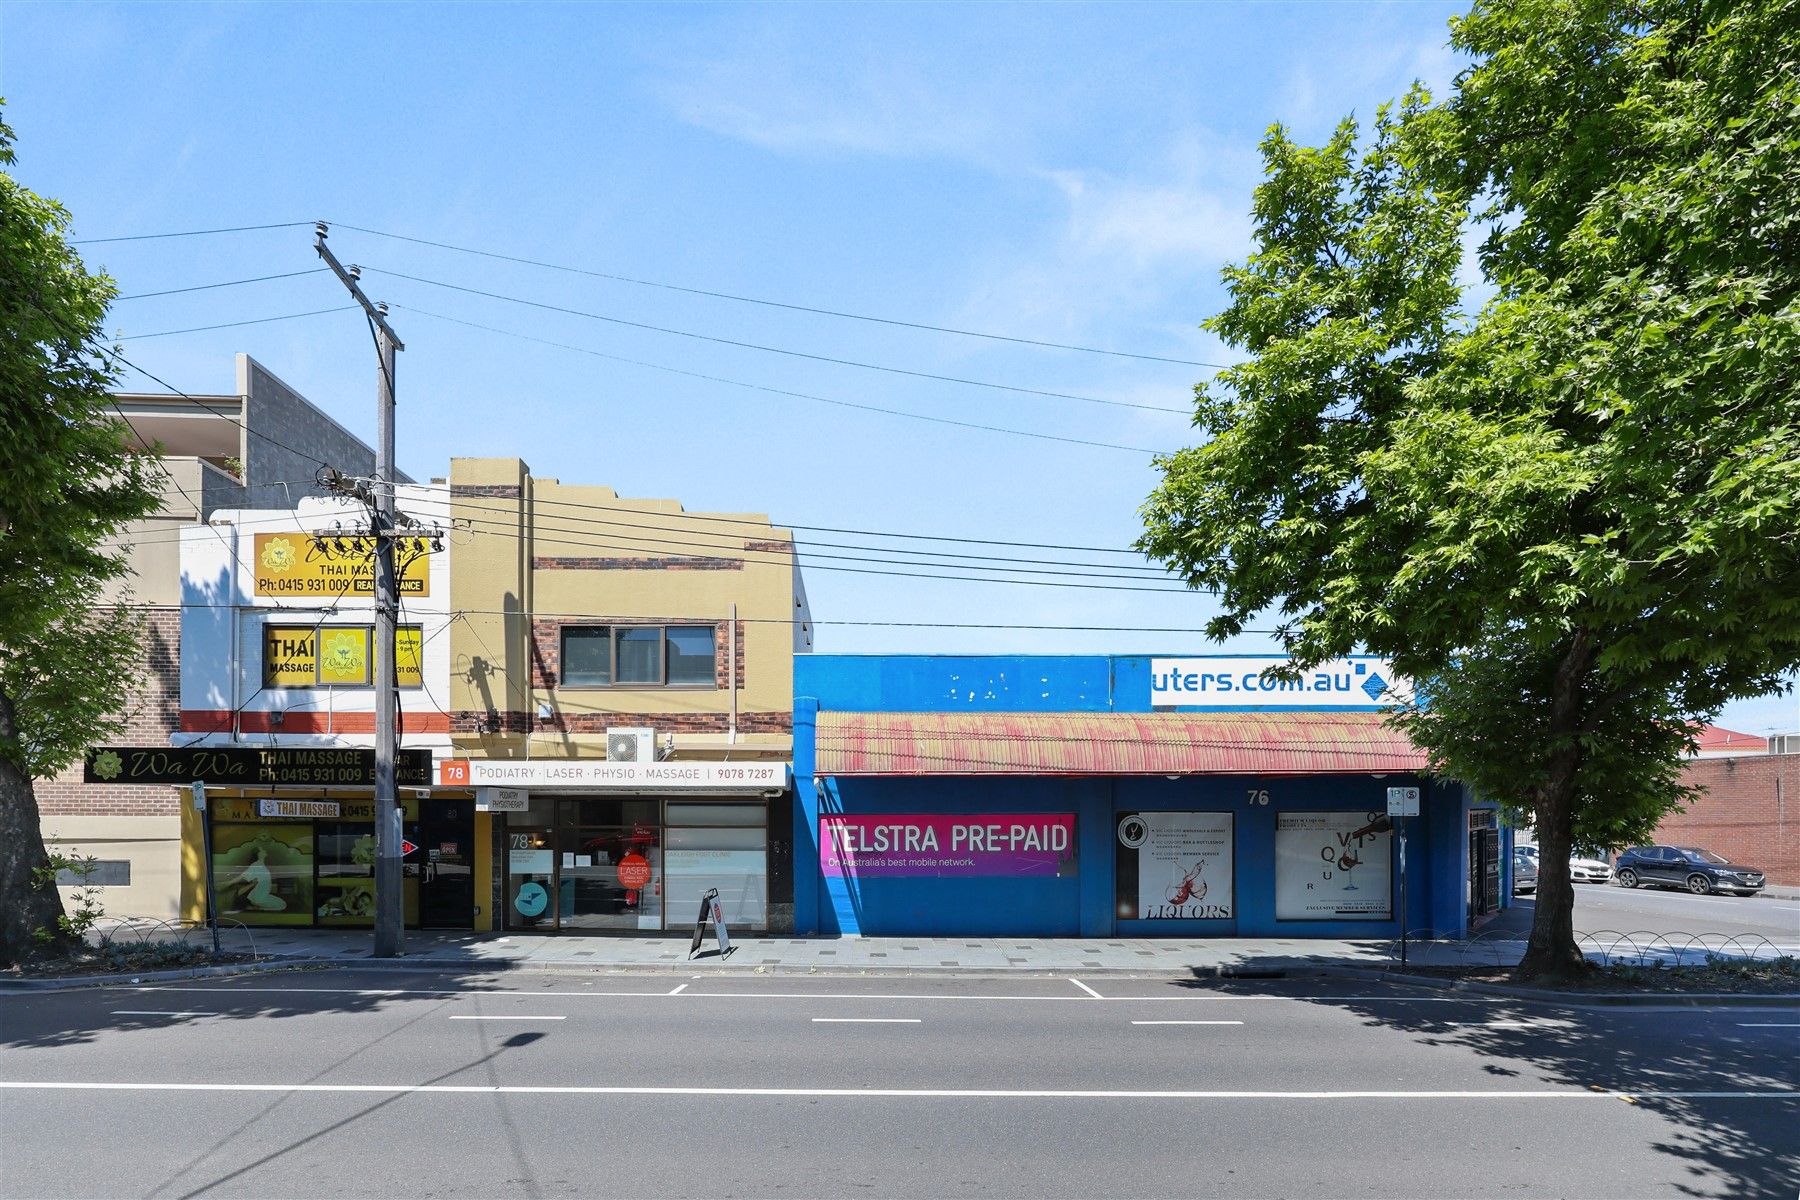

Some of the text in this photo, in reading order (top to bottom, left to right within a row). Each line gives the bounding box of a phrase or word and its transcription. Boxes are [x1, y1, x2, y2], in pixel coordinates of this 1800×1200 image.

[319, 564, 347, 575] THAI
[278, 579, 304, 591] 0415
[307, 579, 326, 591] 931
[328, 579, 350, 591] 009
[270, 639, 314, 657] THAI
[270, 663, 314, 673] MASSAGE
[131, 752, 248, 777] Wa Wa
[259, 752, 291, 765] THAI
[296, 752, 362, 765] MASSAGE
[281, 768, 310, 781] 0415
[314, 768, 335, 781] 931
[338, 768, 362, 781] 009
[447, 767, 463, 779] 78
[479, 768, 774, 779] PODIATRY LASER PHYSIO MASSAGE 9078 7287
[499, 790, 519, 799] PODIATRY
[1247, 790, 1270, 805] 76
[276, 801, 298, 815] THAI
[299, 802, 337, 817] MASSAGE
[492, 800, 525, 809] PHYSIOTHERAPY
[511, 834, 528, 849] 78
[828, 825, 1068, 852] TELSTRA PRE-PAID
[1321, 846, 1335, 864] Q
[828, 858, 976, 867] On Australia's best mobile network.
[620, 866, 648, 875] LASER
[1323, 871, 1332, 881] U
[1145, 904, 1231, 919] LIQUORS
